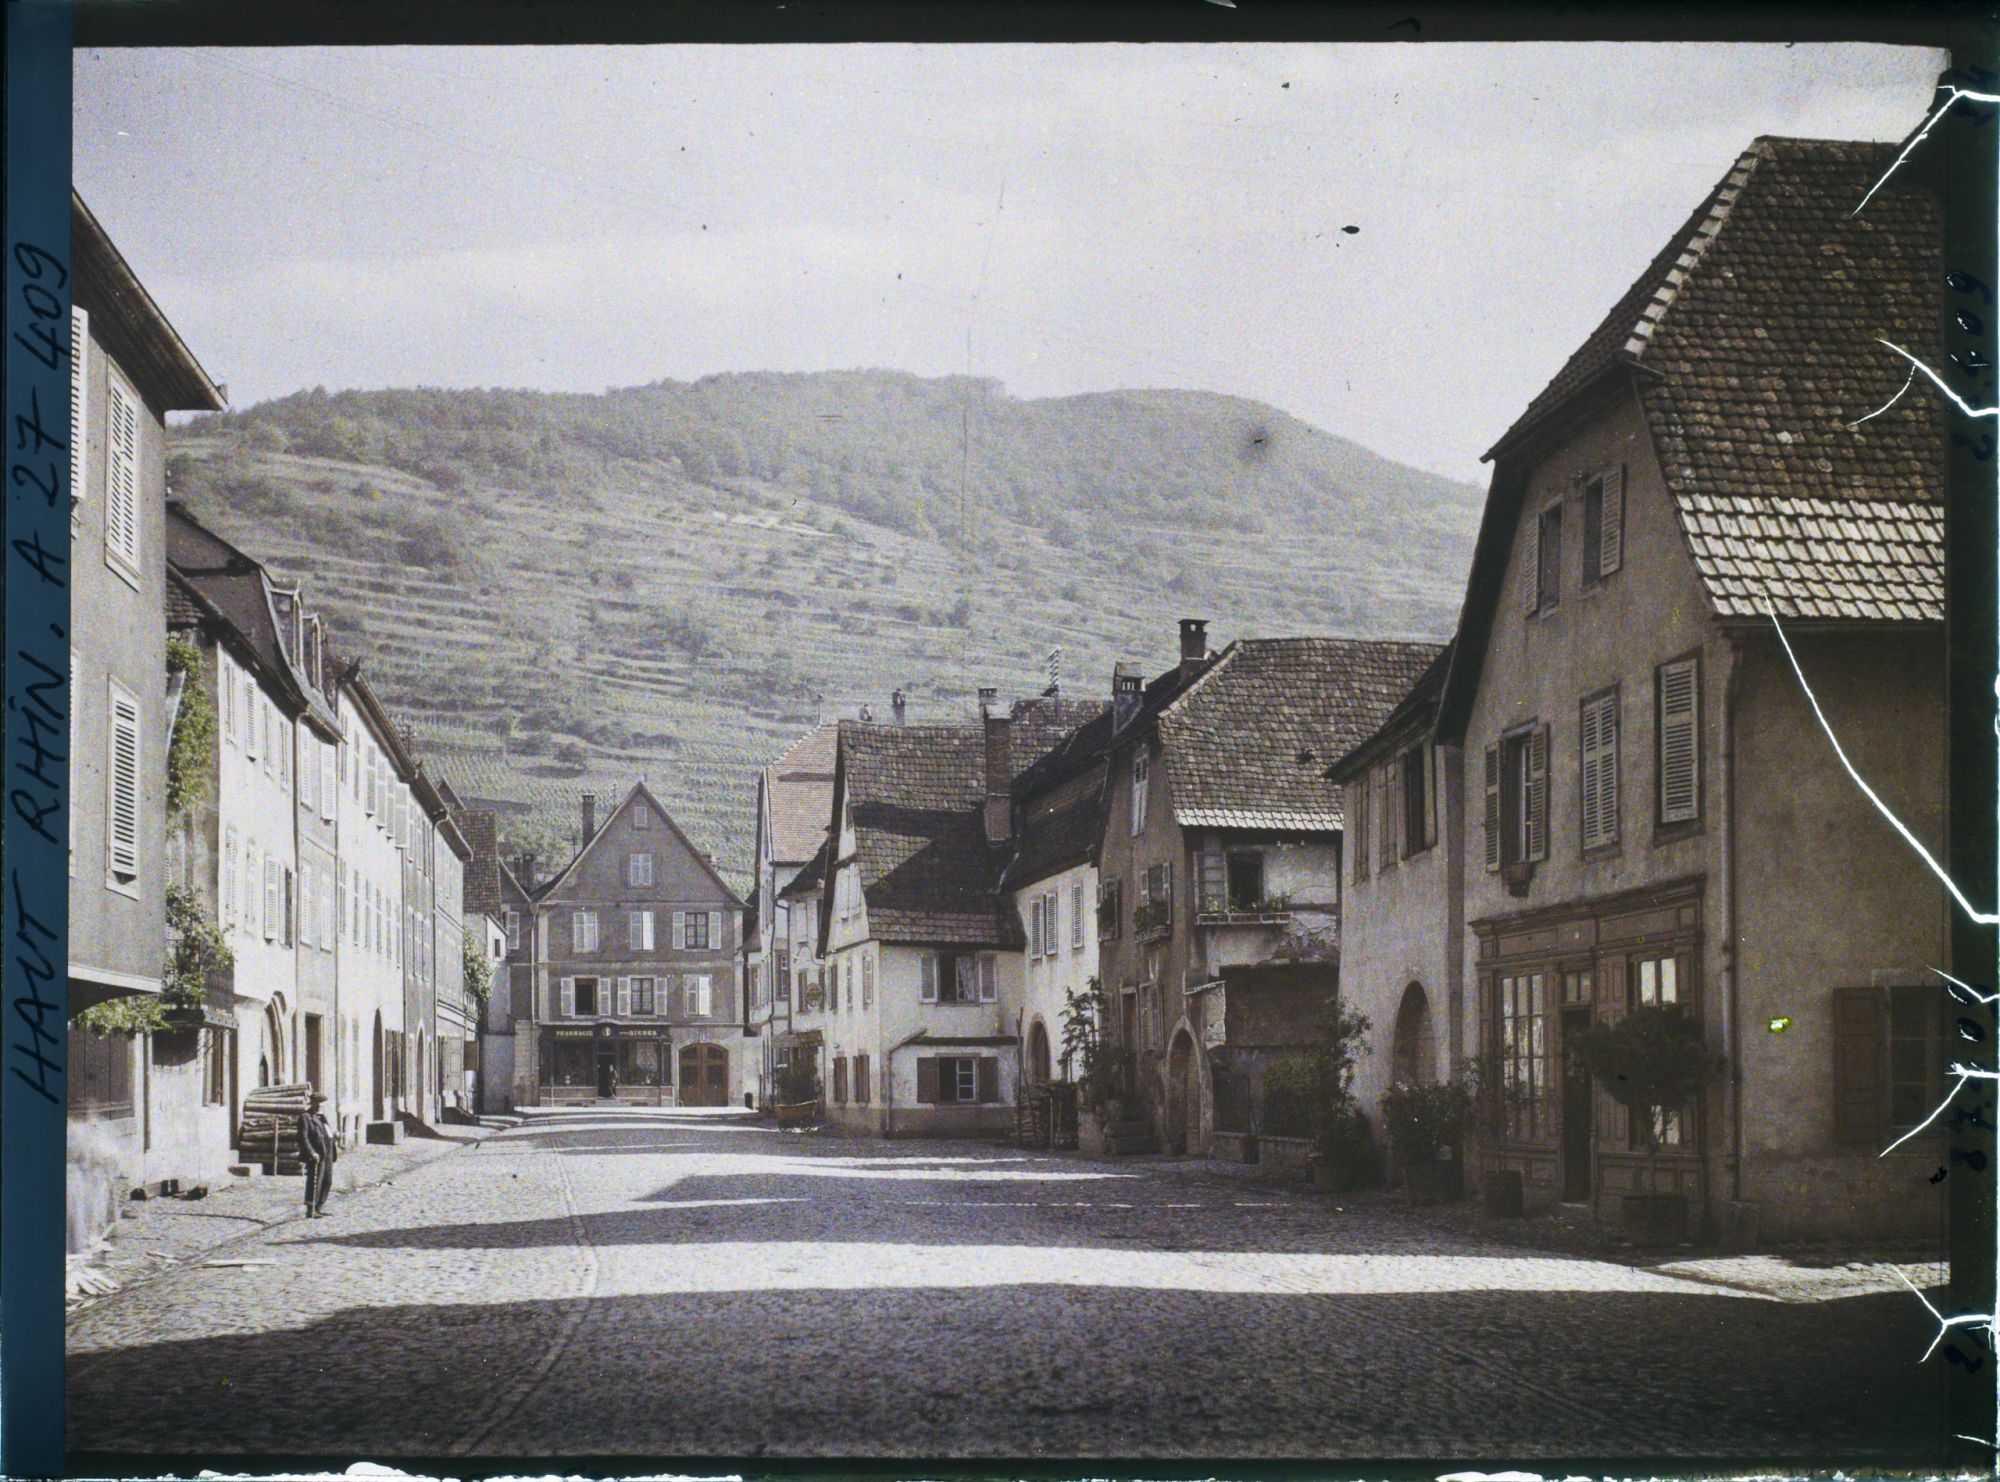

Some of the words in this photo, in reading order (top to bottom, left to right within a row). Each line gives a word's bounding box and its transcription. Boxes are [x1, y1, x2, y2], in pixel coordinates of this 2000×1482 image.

[14, 242, 71, 370] 409
[12, 386, 66, 507] 27
[12, 530, 66, 588] A
[10, 868, 63, 1104] HAUT
